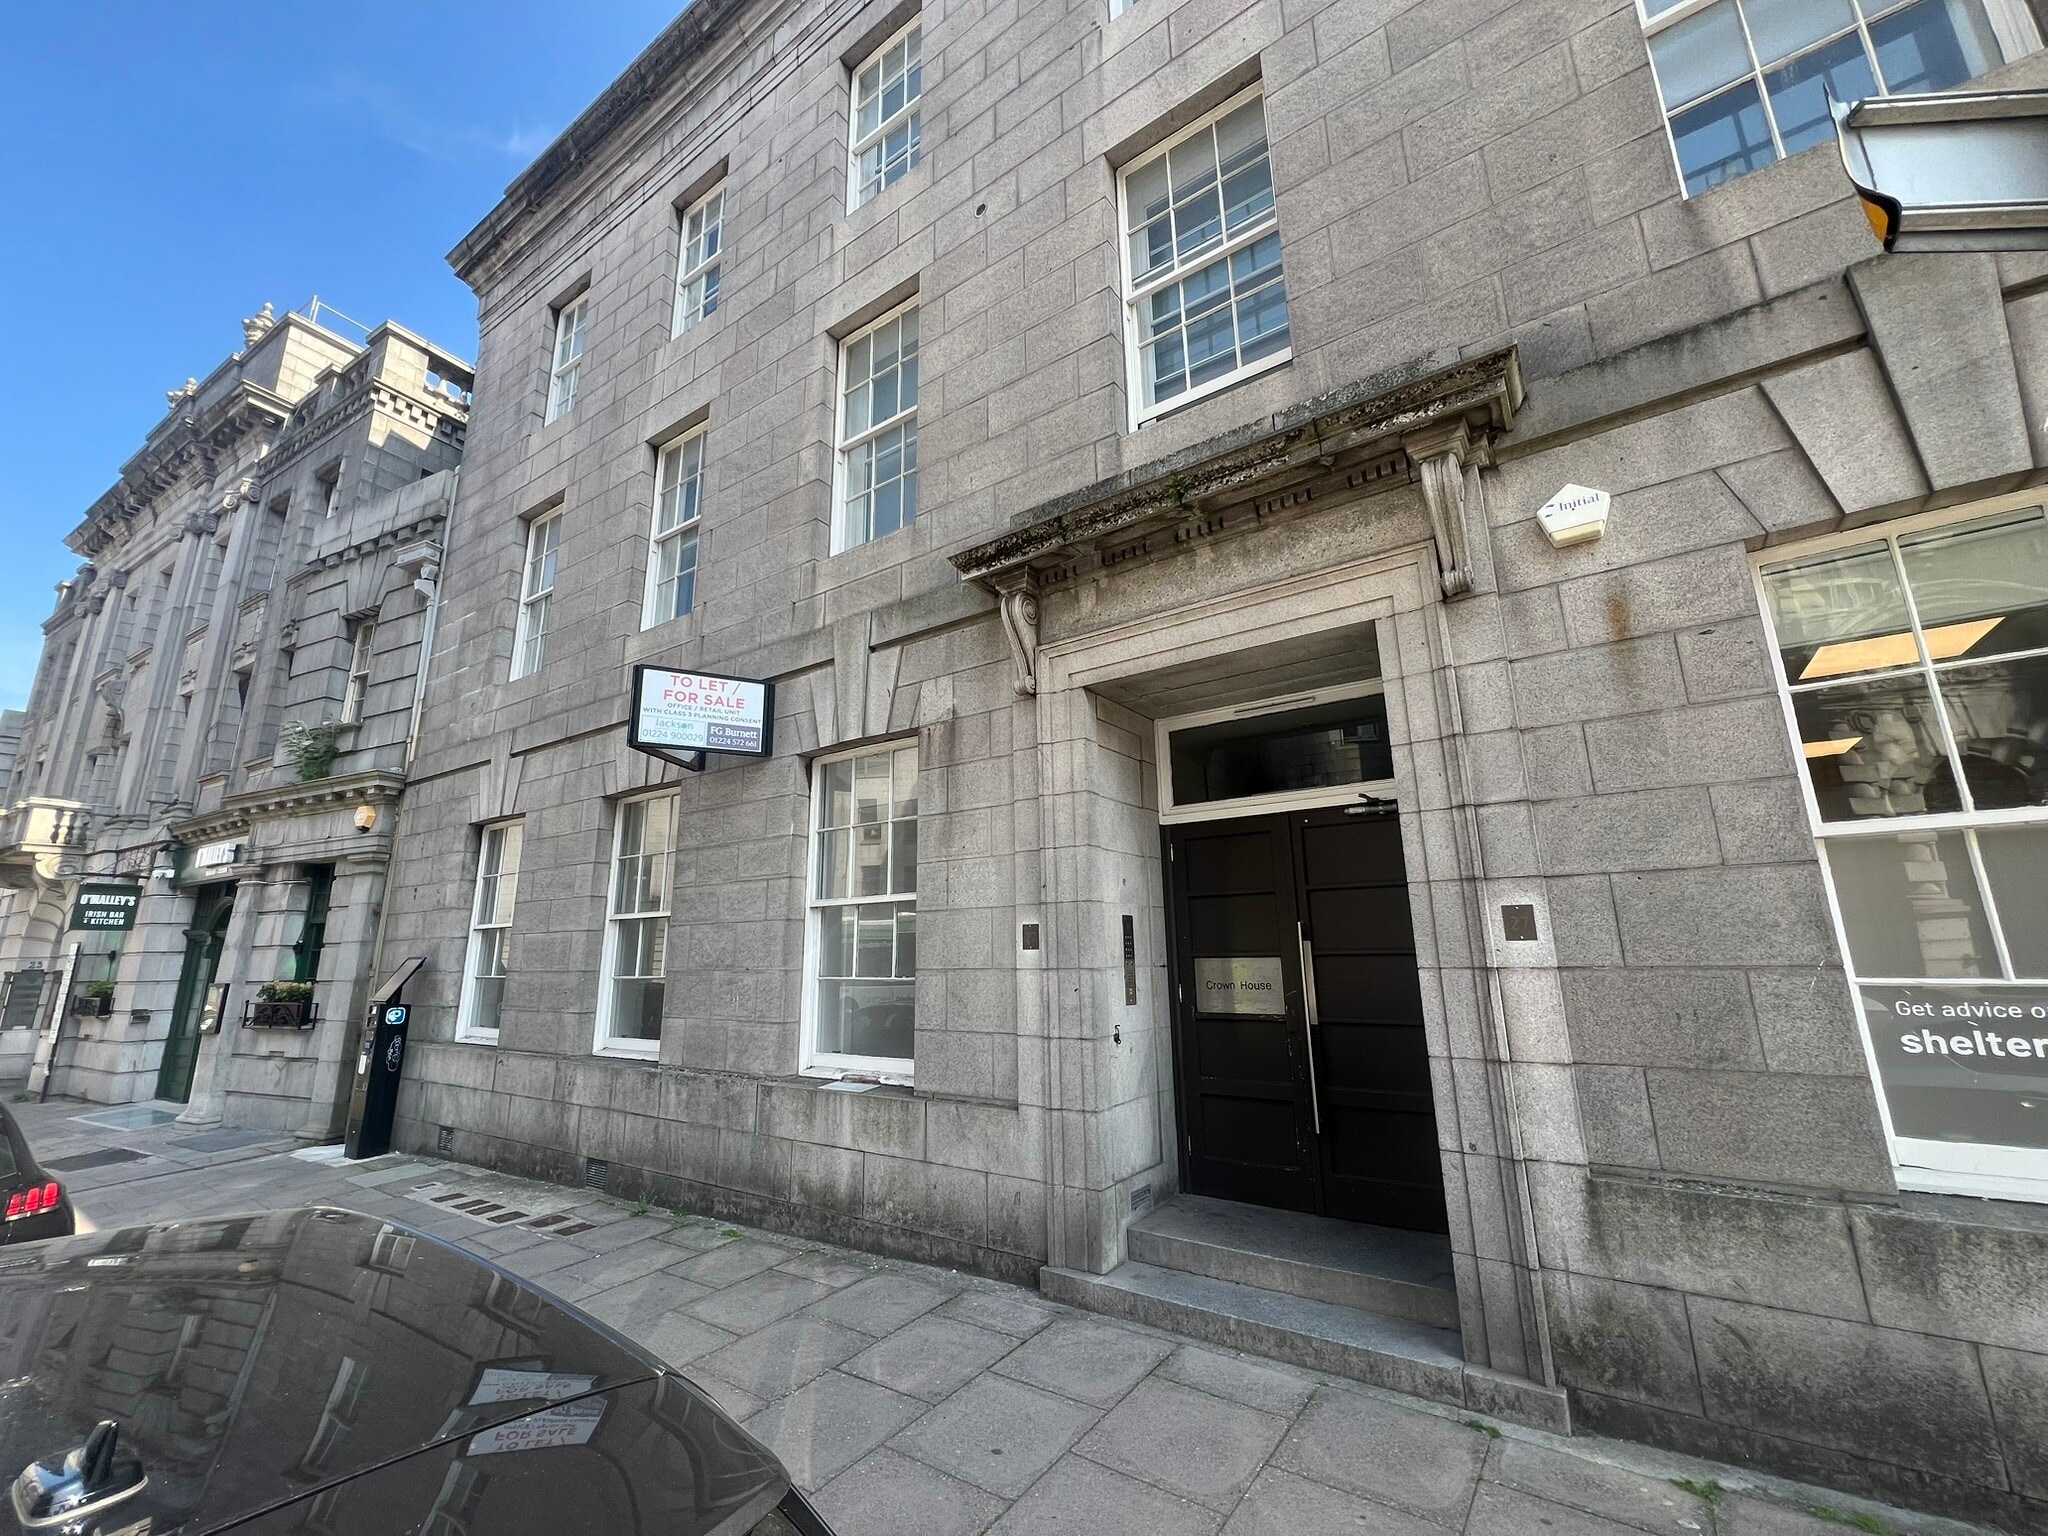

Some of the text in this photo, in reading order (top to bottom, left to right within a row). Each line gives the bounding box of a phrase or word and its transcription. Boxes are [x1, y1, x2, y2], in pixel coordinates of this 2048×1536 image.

[1559, 492, 1600, 511] Initial
[670, 674, 693, 688] TO
[698, 678, 728, 693] LET
[663, 689, 745, 710] FOR SALE
[643, 706, 663, 714] WITH
[663, 709, 687, 717] CLASS
[693, 712, 729, 722] PLANNING
[730, 716, 762, 724] CONSENT
[700, 705, 722, 714] RETAIL
[655, 718, 694, 730] Jackson
[642, 728, 704, 742] 01224 900029
[710, 725, 758, 739] FG Burnett
[709, 736, 757, 748] 01224 572 661
[80, 894, 136, 906] O'MALLEY'S
[84, 910, 125, 919] IRISH BAR
[90, 917, 125, 926] KITCHEN
[1509, 914, 1530, 931] 27
[1205, 980, 1272, 991] Crown House
[1895, 1000, 2048, 1019] Get advice o
[1900, 1028, 2048, 1058] shelter
